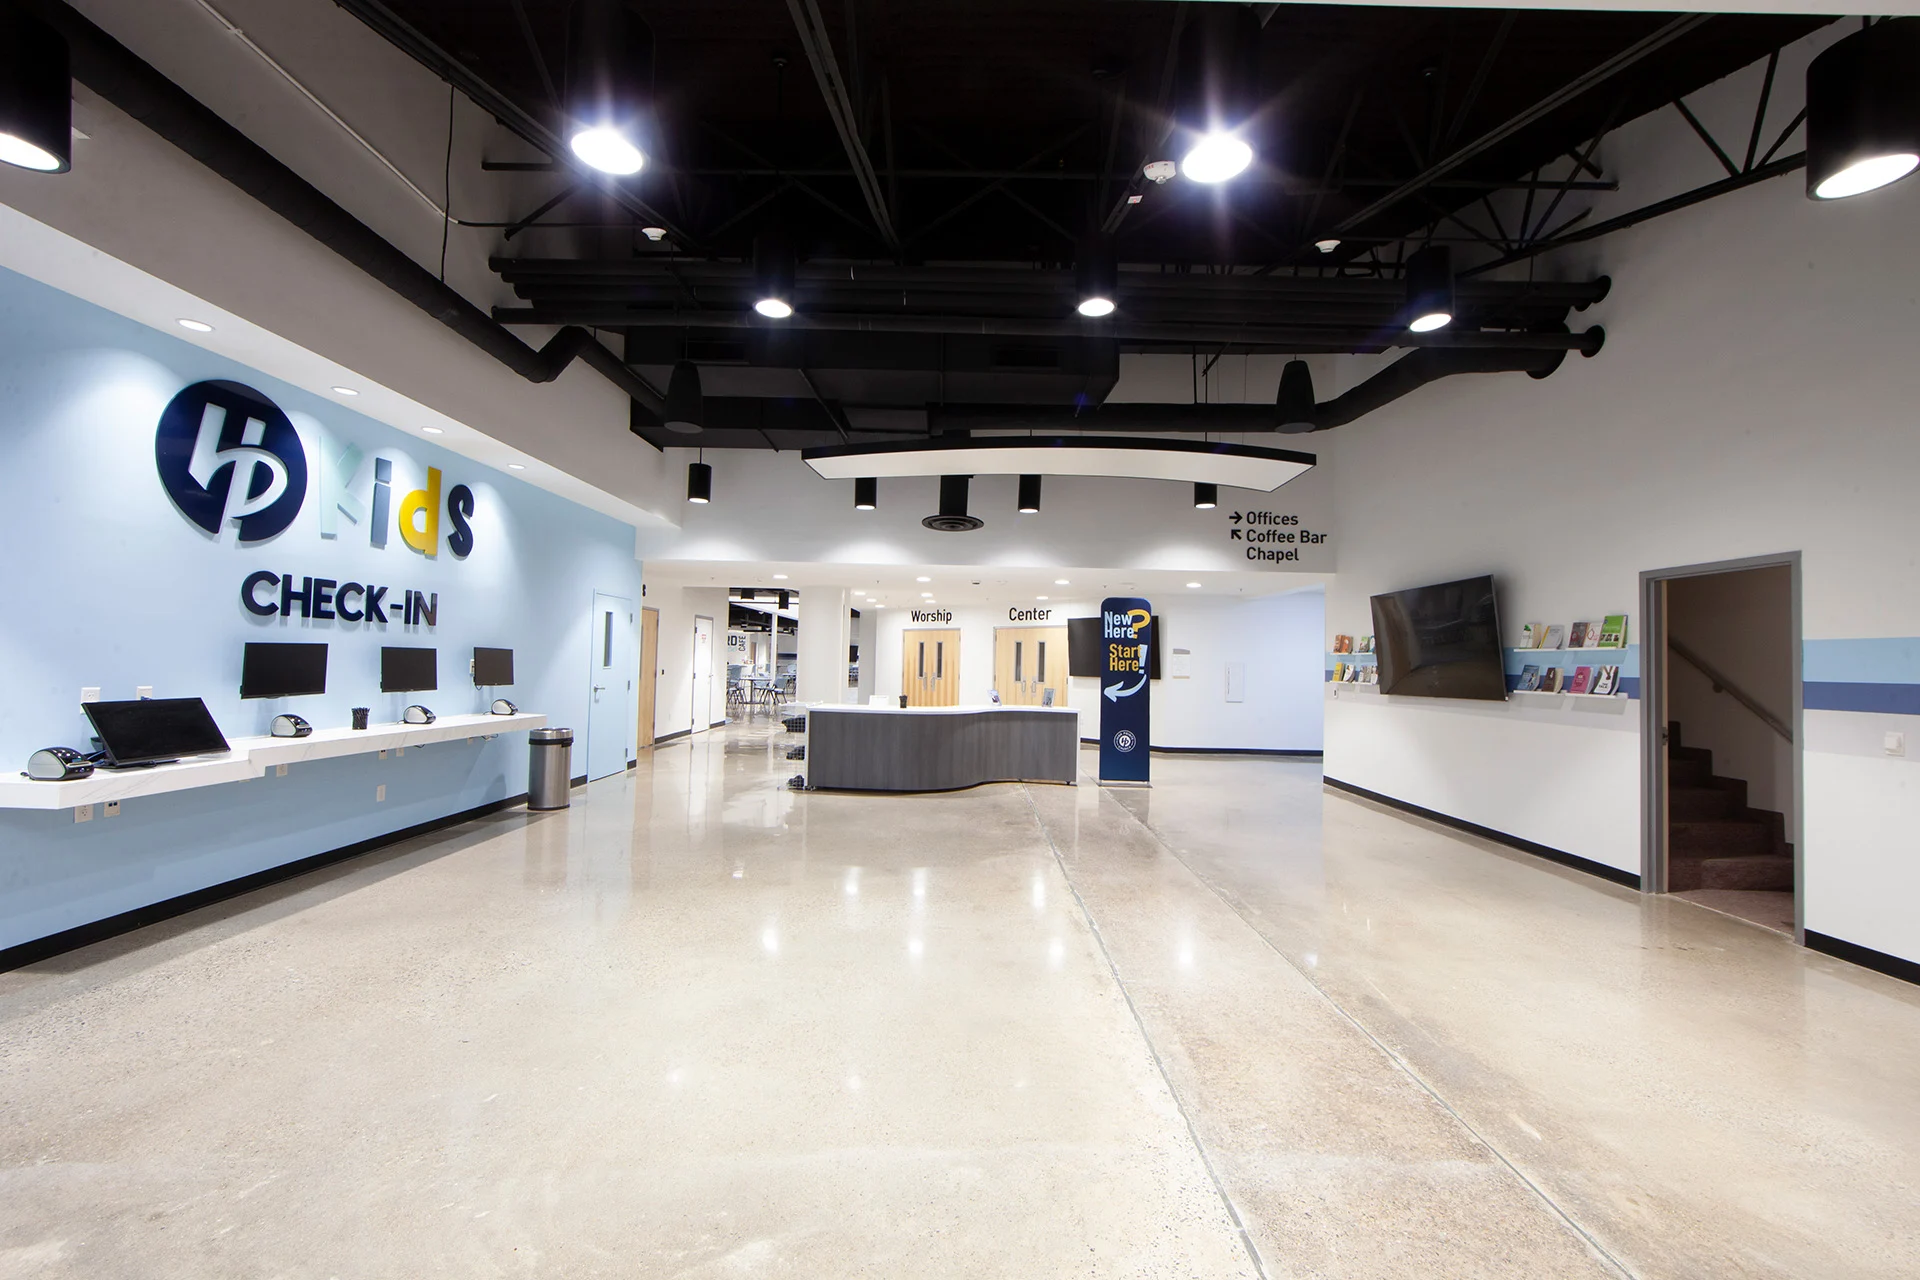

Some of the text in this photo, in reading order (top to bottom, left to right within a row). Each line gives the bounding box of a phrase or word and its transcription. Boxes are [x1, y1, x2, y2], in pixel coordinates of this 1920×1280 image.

[319, 435, 475, 559] kids
[1246, 511, 1299, 526] Offices
[1246, 529, 1327, 544] Coffee Bar
[1246, 546, 1300, 564] Chapel
[241, 570, 438, 627] CHECK-IN
[911, 607, 1052, 625] Worship Center
[1104, 611, 1133, 626] New
[1109, 643, 1142, 658] Start
